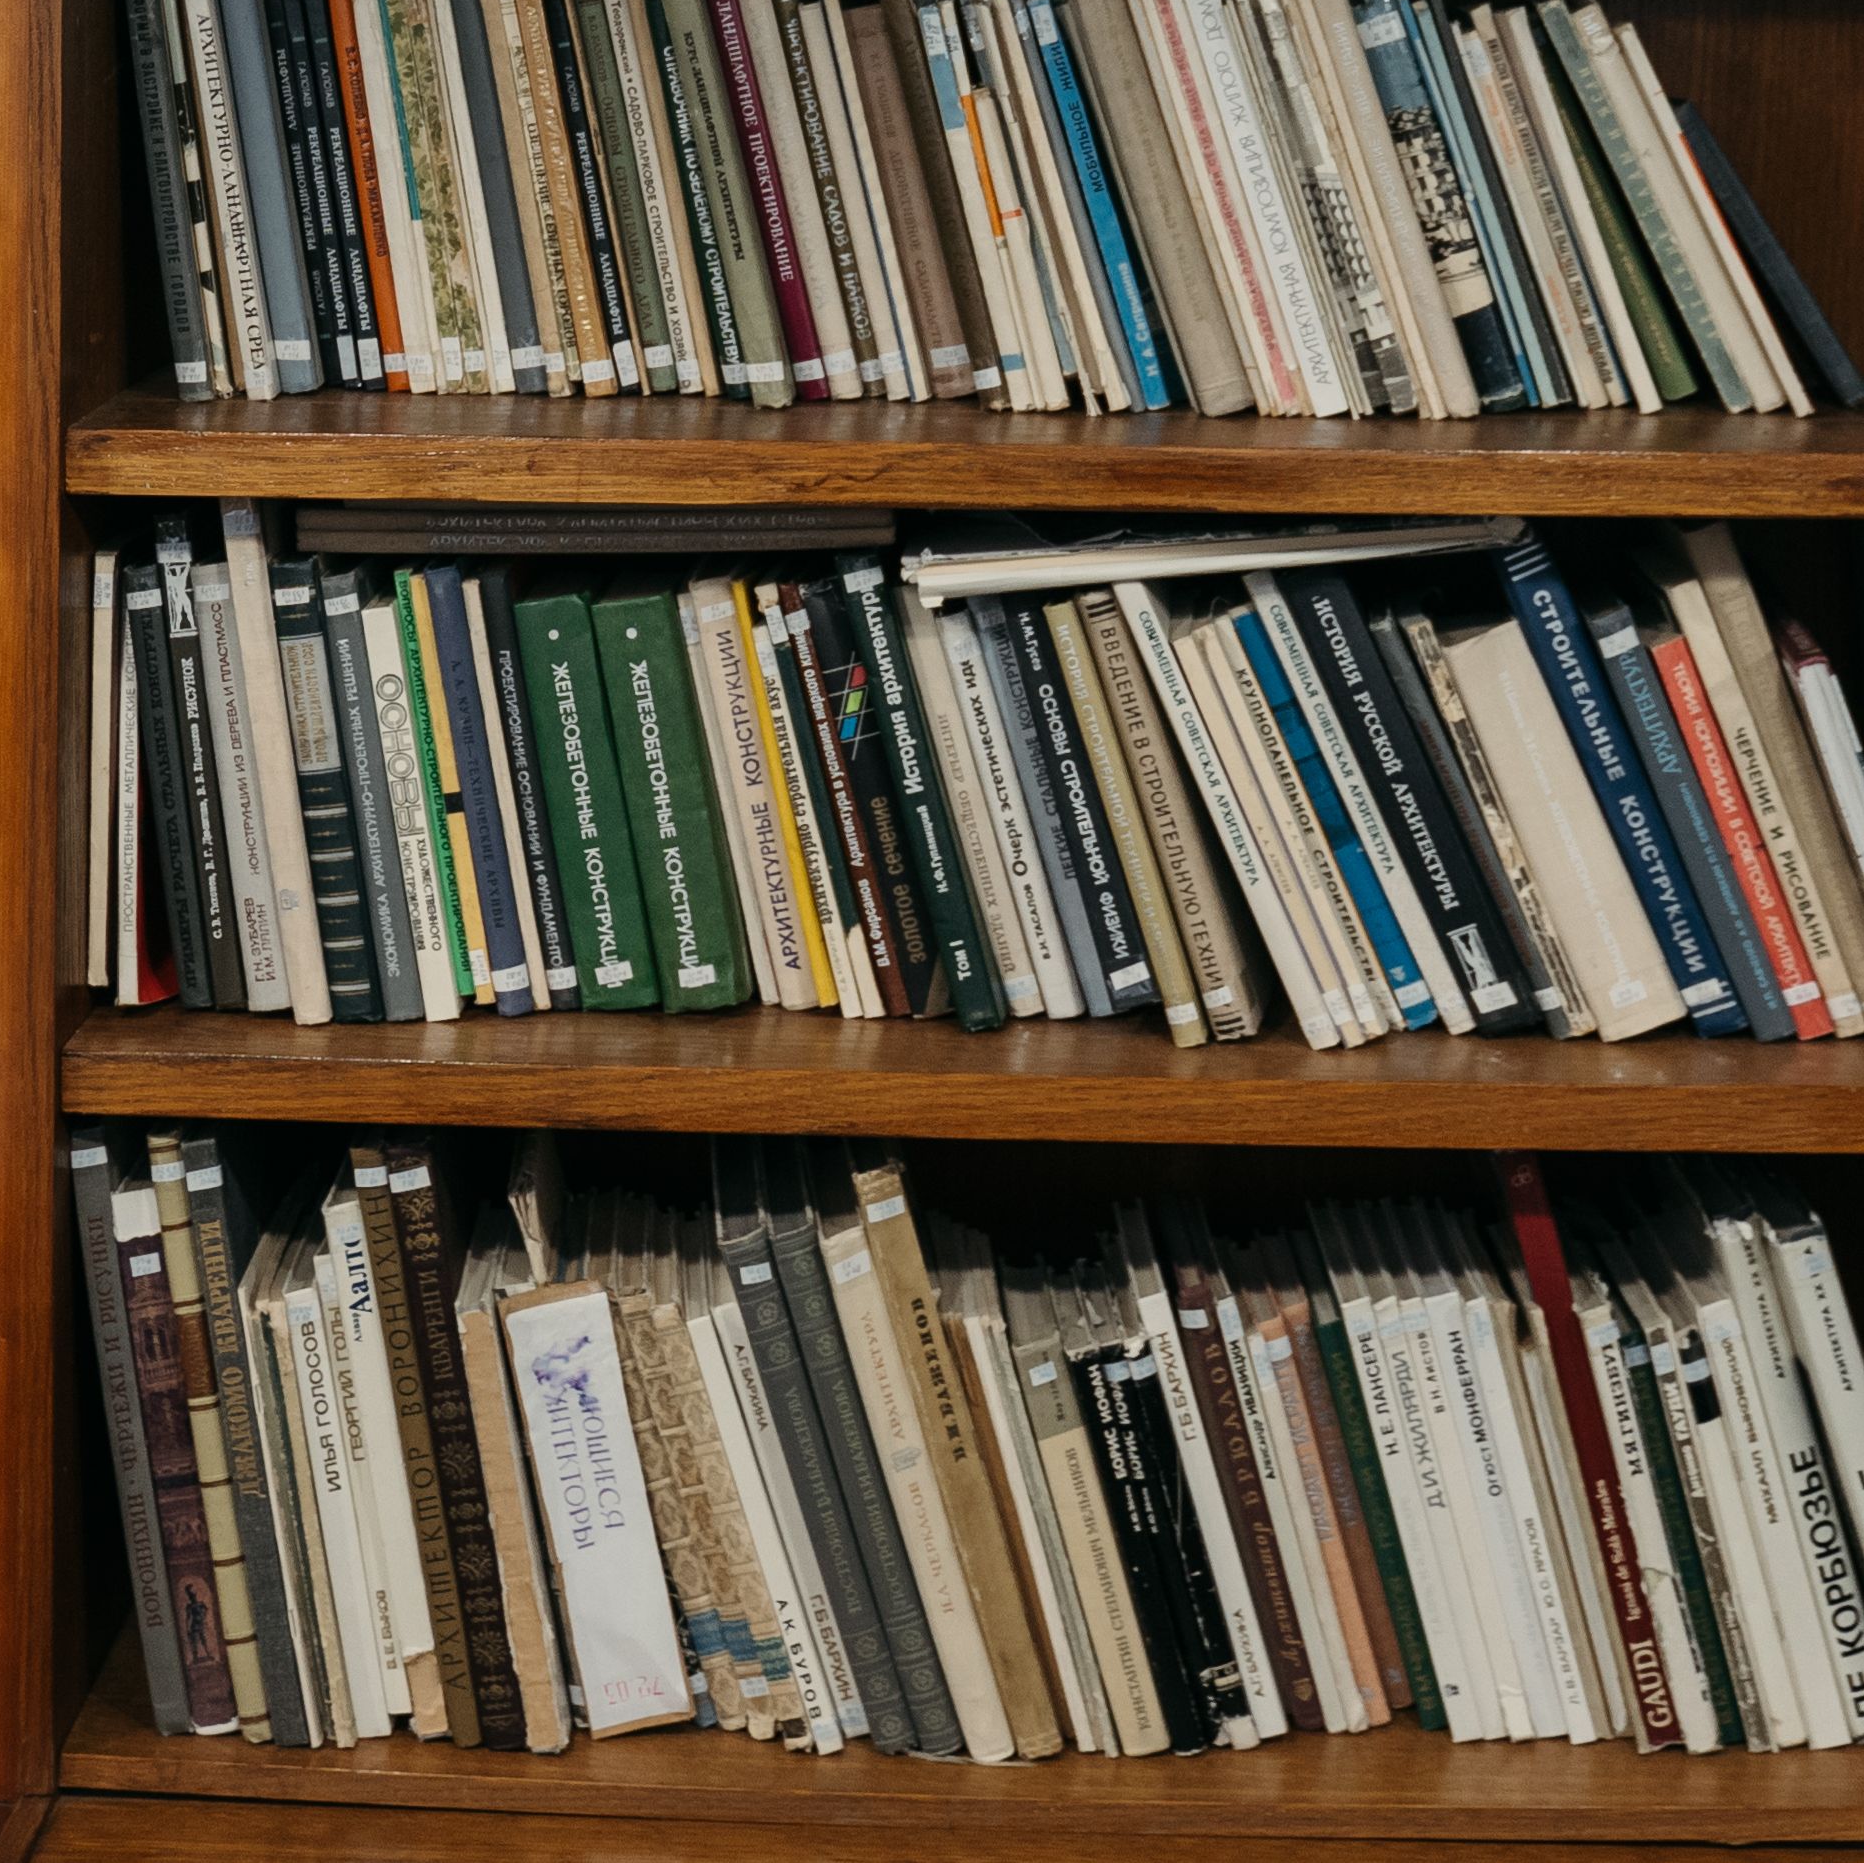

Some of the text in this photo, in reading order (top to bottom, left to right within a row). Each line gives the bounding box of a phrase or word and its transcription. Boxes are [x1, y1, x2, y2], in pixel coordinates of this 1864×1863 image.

[715, 0, 793, 282] ЛАНДШАФТНОЕ ПРОЕКТИРОВАНИЕ
[1212, 49, 1249, 127] ЖИЛОГО
[327, 126, 371, 331] РЕКРЕАЦИОННЫЕ ЛАНДШАФТЫ
[1238, 132, 1290, 255] КОМПОЗИЦИЯ
[1278, 260, 1331, 388] АРХИТЕКТУРНАЯ
[335, 637, 401, 977] ЭКОНОМИКА АРХИТЕКТУРНО-ПРОЕКТНЫХ РЕШЕНИЙ
[374, 672, 425, 838] ОСНОВЫ
[549, 660, 598, 839] ЖЕЛЕЗОБЕТОННЫЕ
[714, 629, 801, 971] АРХИТЕКТУРНЫЕ КОНСТРУКЦИИ
[887, 710, 926, 794] История
[1037, 682, 1128, 960] ОСНОВЫ СТРОИТЕЛЬНОЙ ФИЗИКИ
[1312, 598, 1459, 912] ИСТОРИЯ РУССКОЙ АРХИТЕКТУРЫ
[1530, 586, 1706, 975] СТРОИТЕЛЬНЫЕ КОНСТРУКЦИИ
[415, 838, 442, 951] ХУДОЖЕСТВЕННОГО
[868, 795, 928, 963] золотое сечение
[365, 1193, 424, 1416] ВОРОНИХИН
[1447, 1329, 1488, 1443] МОНФЕРРАН
[299, 1320, 341, 1492] ИЛЬЯ ГОЛОСОВ
[1086, 1364, 1128, 1478] БОРИС ИОФАН
[809, 1592, 853, 1702] Г.Б.БАРХИН
[1628, 1636, 1674, 1729] GAUDI
